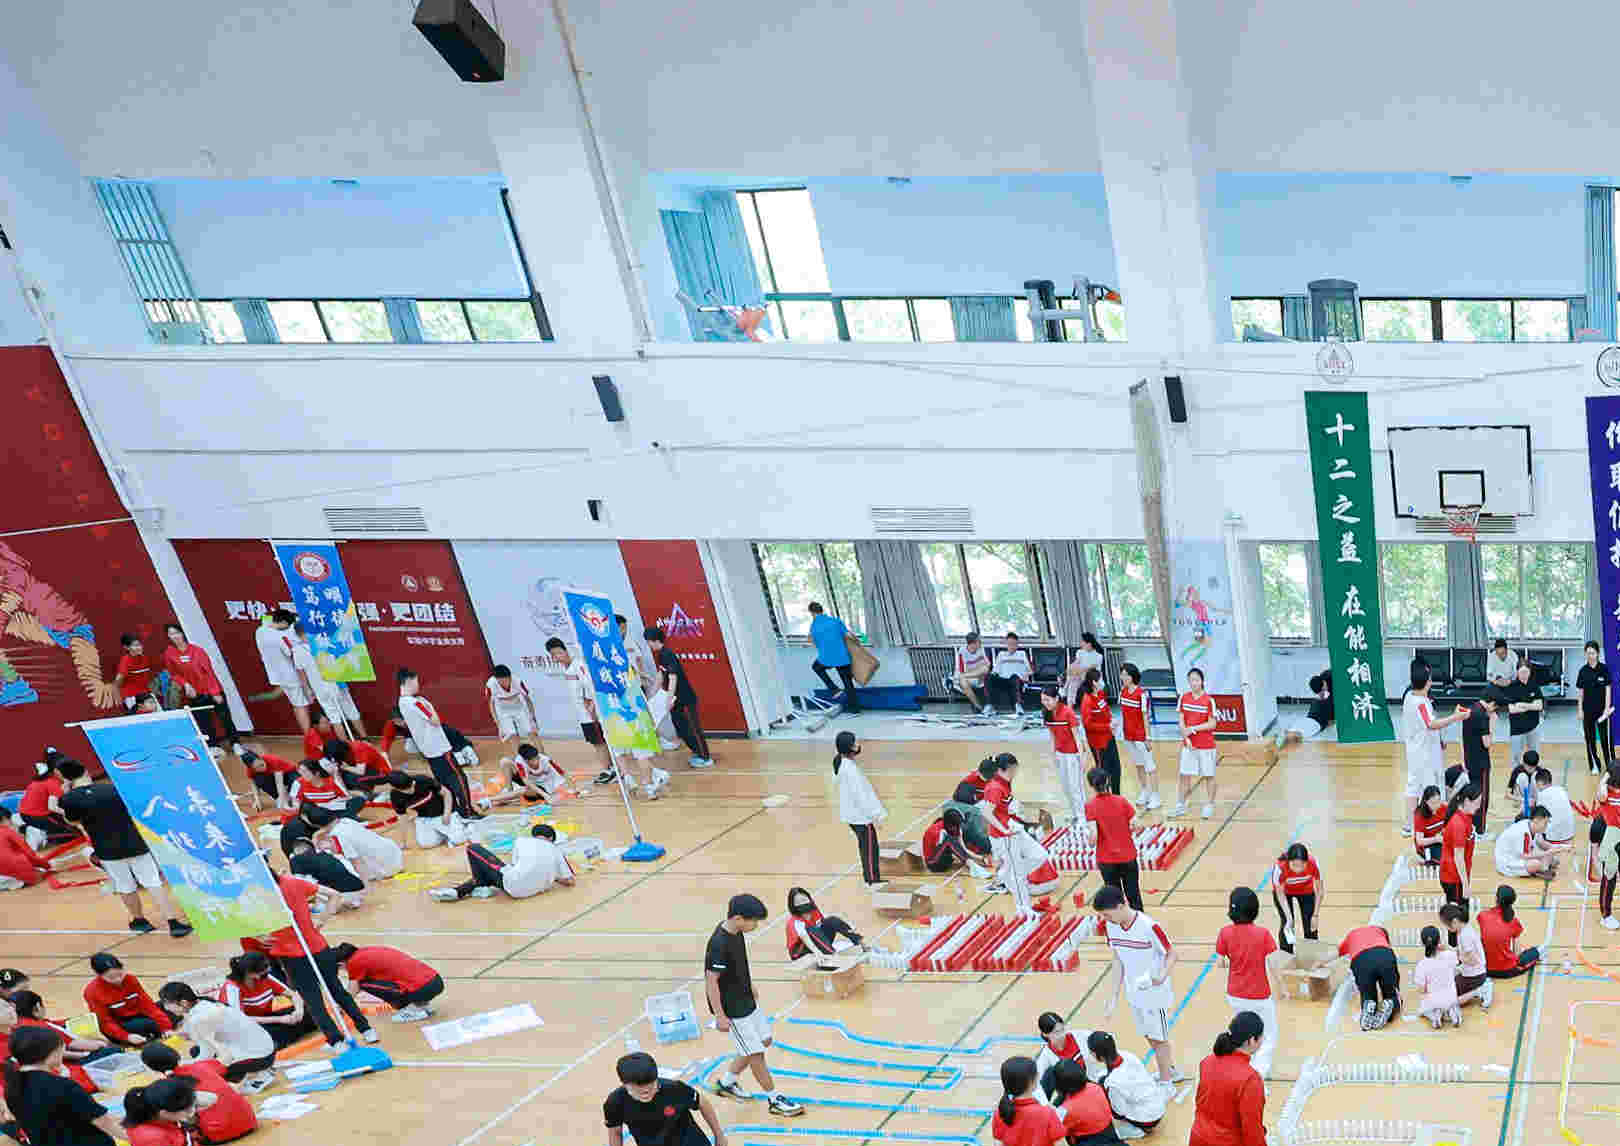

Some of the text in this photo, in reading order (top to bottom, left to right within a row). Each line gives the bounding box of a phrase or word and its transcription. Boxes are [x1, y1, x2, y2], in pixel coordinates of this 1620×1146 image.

[1324, 413, 1362, 563] 十二之益
[1341, 584, 1381, 724] 在能相济
